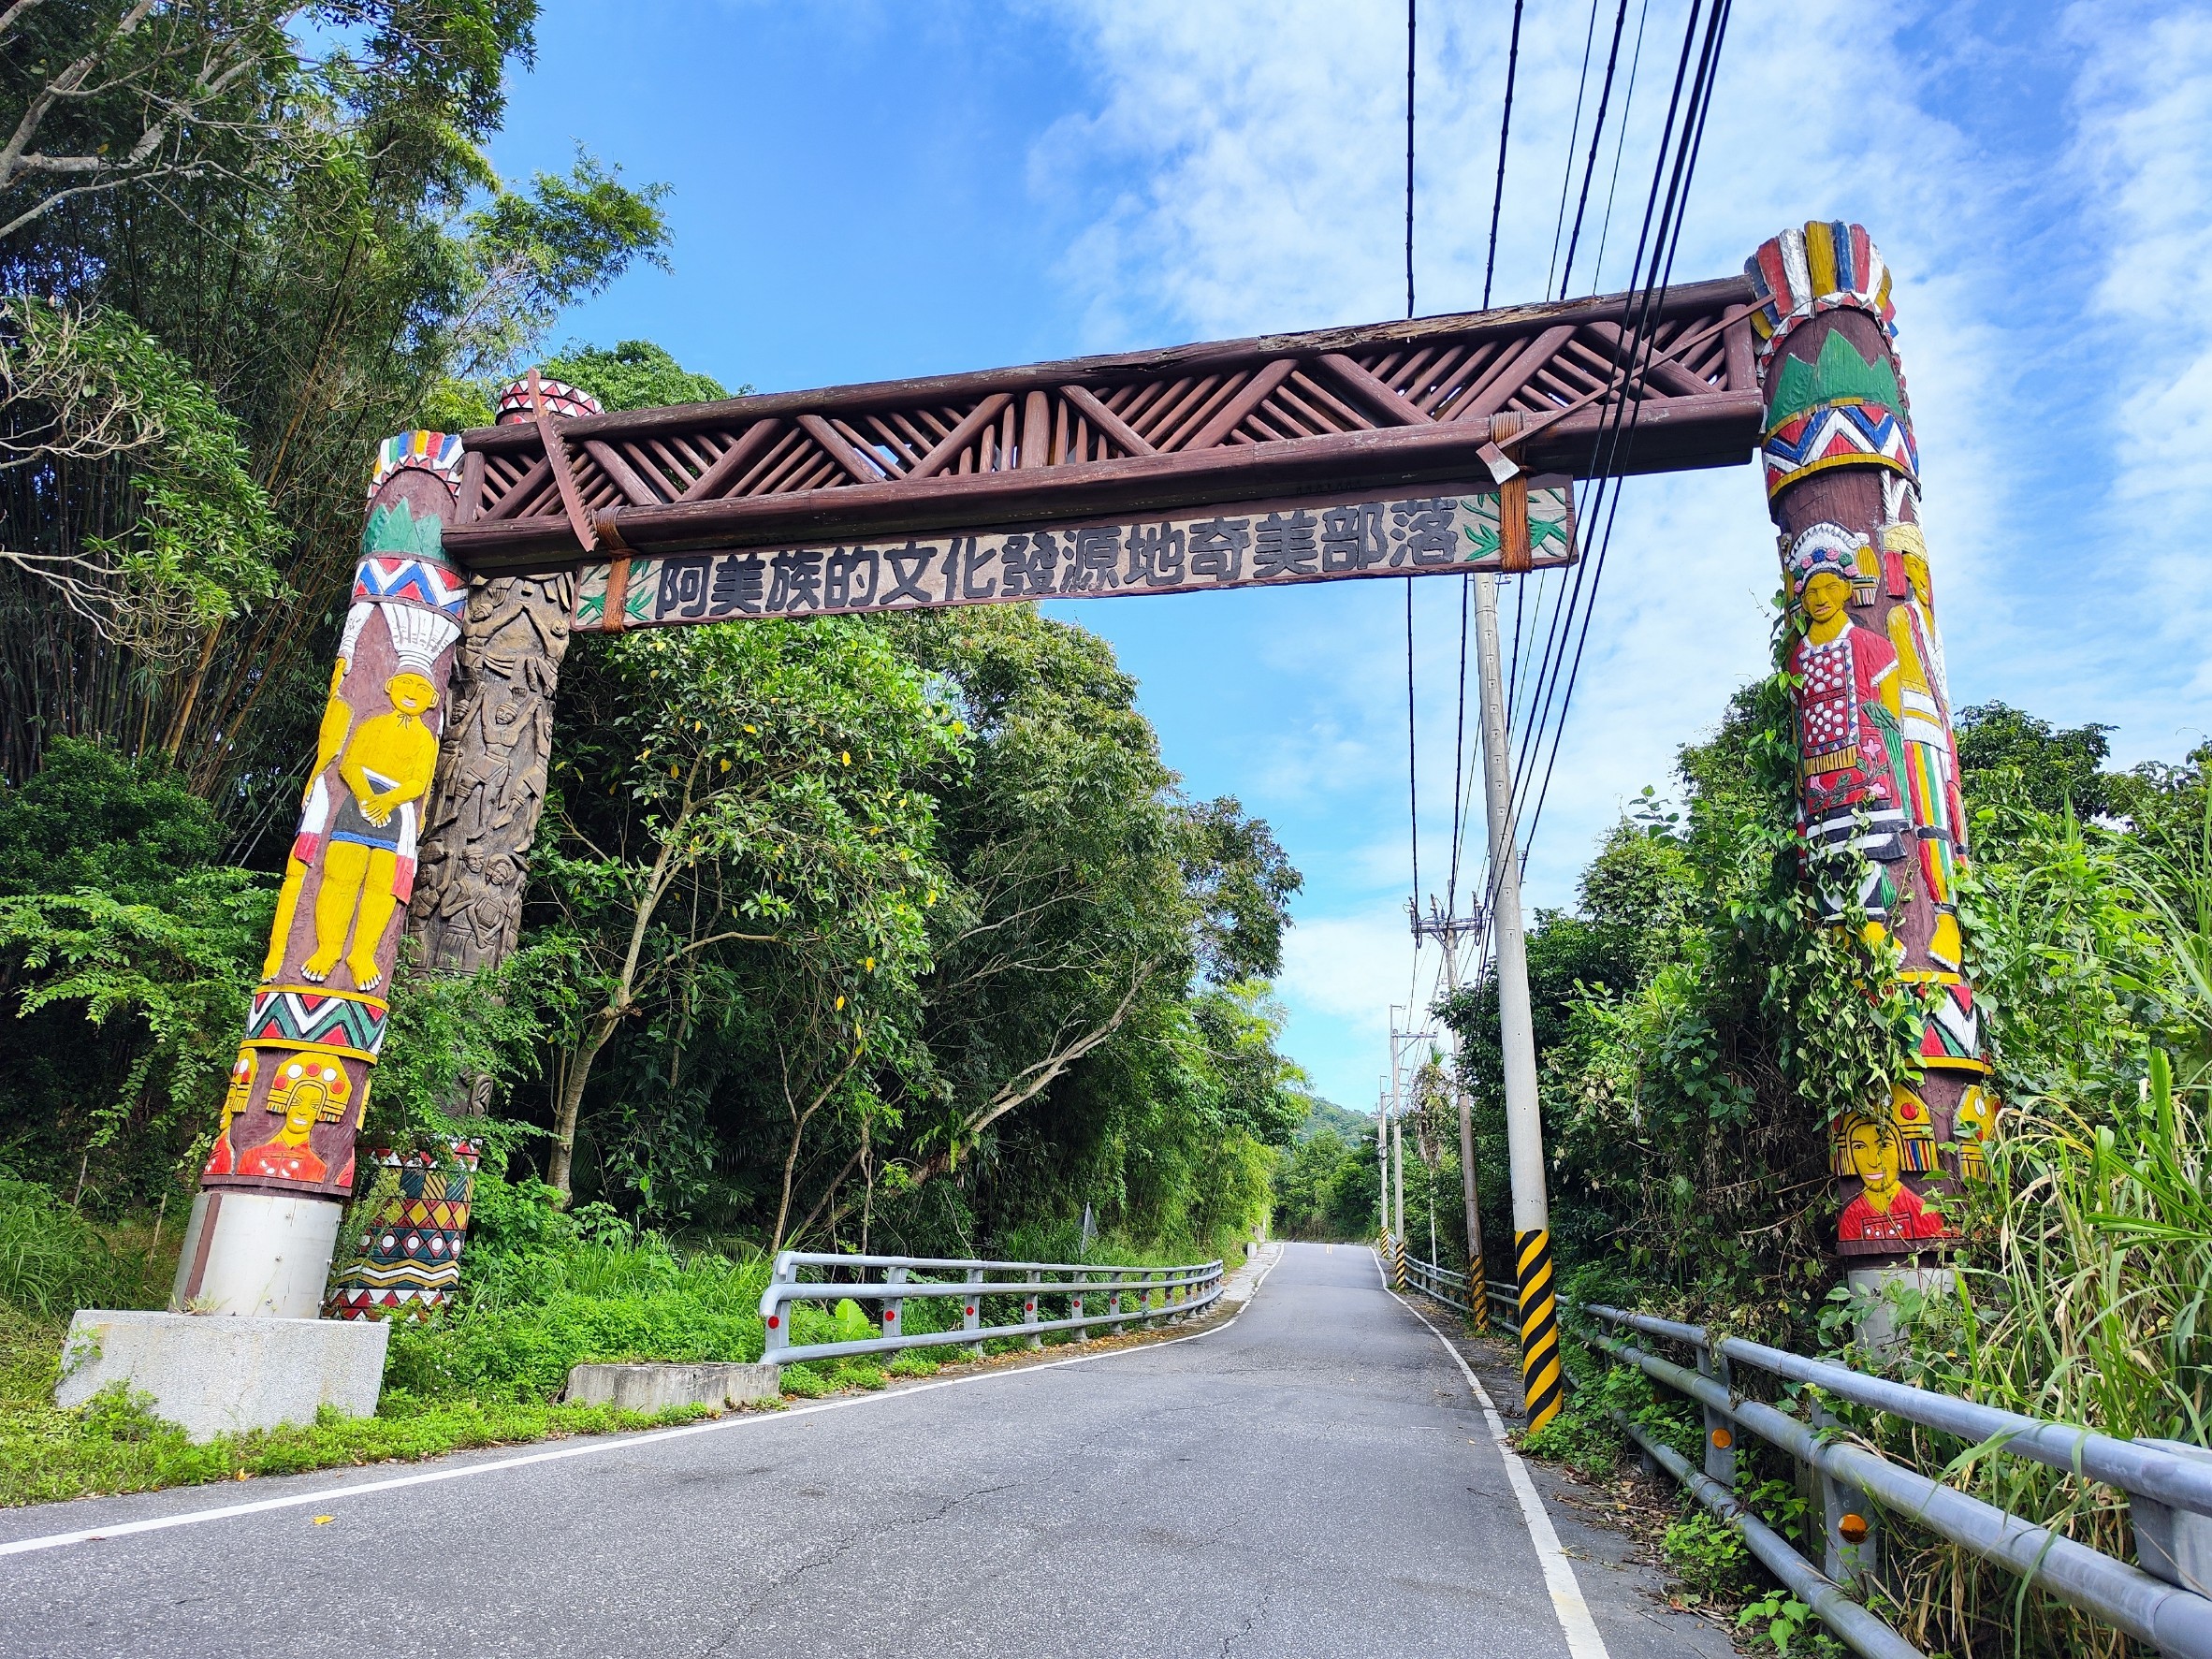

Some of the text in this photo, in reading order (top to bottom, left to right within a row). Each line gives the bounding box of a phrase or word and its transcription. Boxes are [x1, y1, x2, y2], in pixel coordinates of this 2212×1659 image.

[655, 498, 1459, 618] 阿美族的文化發源地奇美部落
